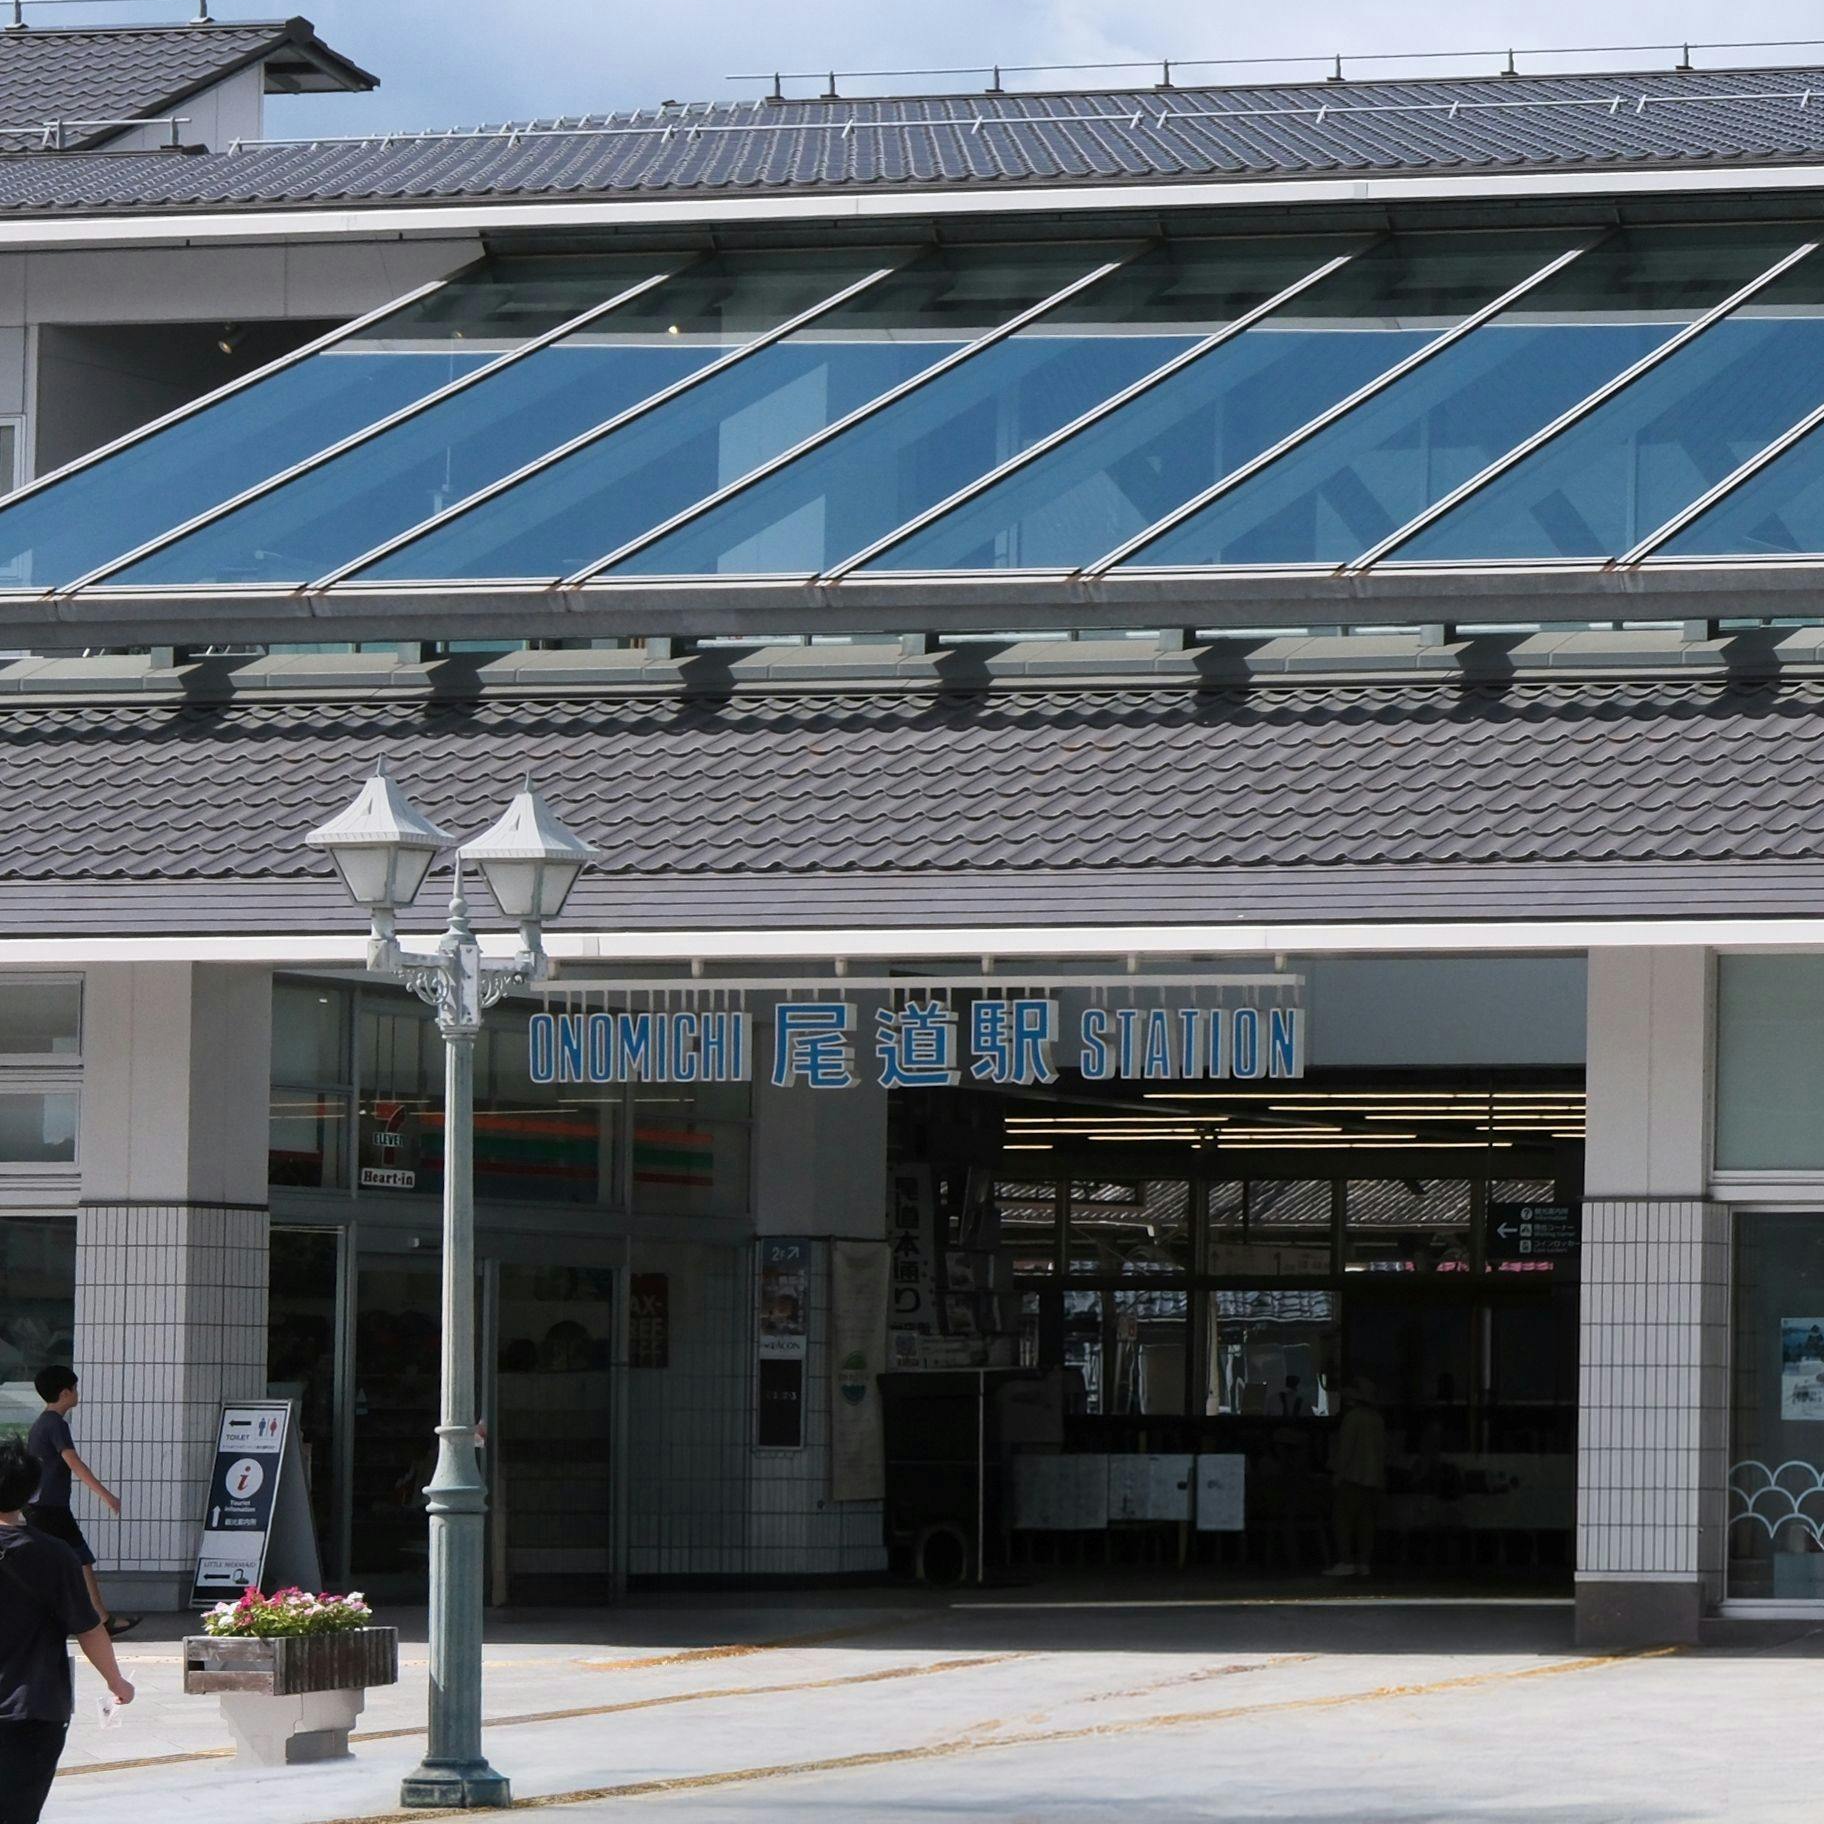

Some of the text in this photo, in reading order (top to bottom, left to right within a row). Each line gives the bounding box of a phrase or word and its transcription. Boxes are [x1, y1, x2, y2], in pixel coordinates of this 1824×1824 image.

[529, 999, 1303, 1089] ONOMICHI 尾道駅 STATION
[362, 1169, 413, 1186] Heart-in
